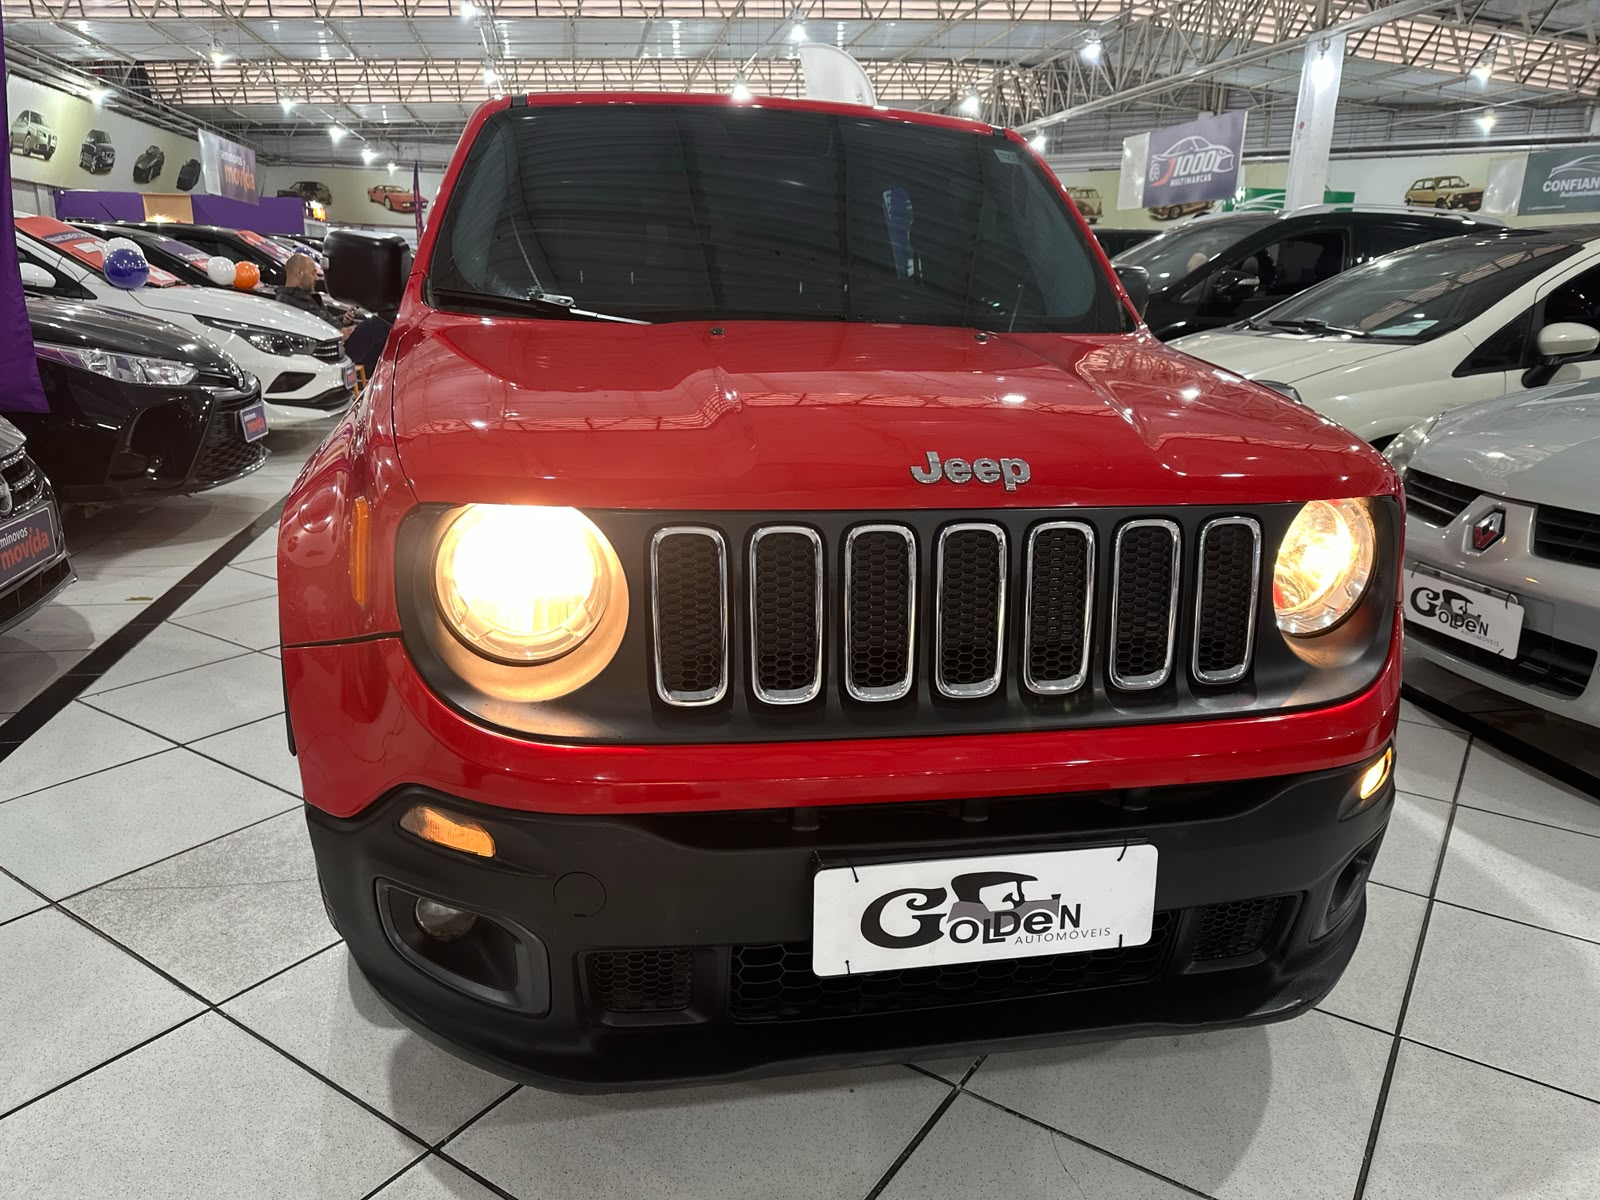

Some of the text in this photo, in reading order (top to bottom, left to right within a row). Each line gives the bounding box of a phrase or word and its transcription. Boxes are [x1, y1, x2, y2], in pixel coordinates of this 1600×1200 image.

[1170, 173, 1212, 187] MULTIMARCAS
[910, 451, 1031, 491] Jeep
[0, 527, 28, 549] minovos
[1, 527, 50, 571] movida
[1014, 926, 1112, 945] AUTOMÓVEIS
